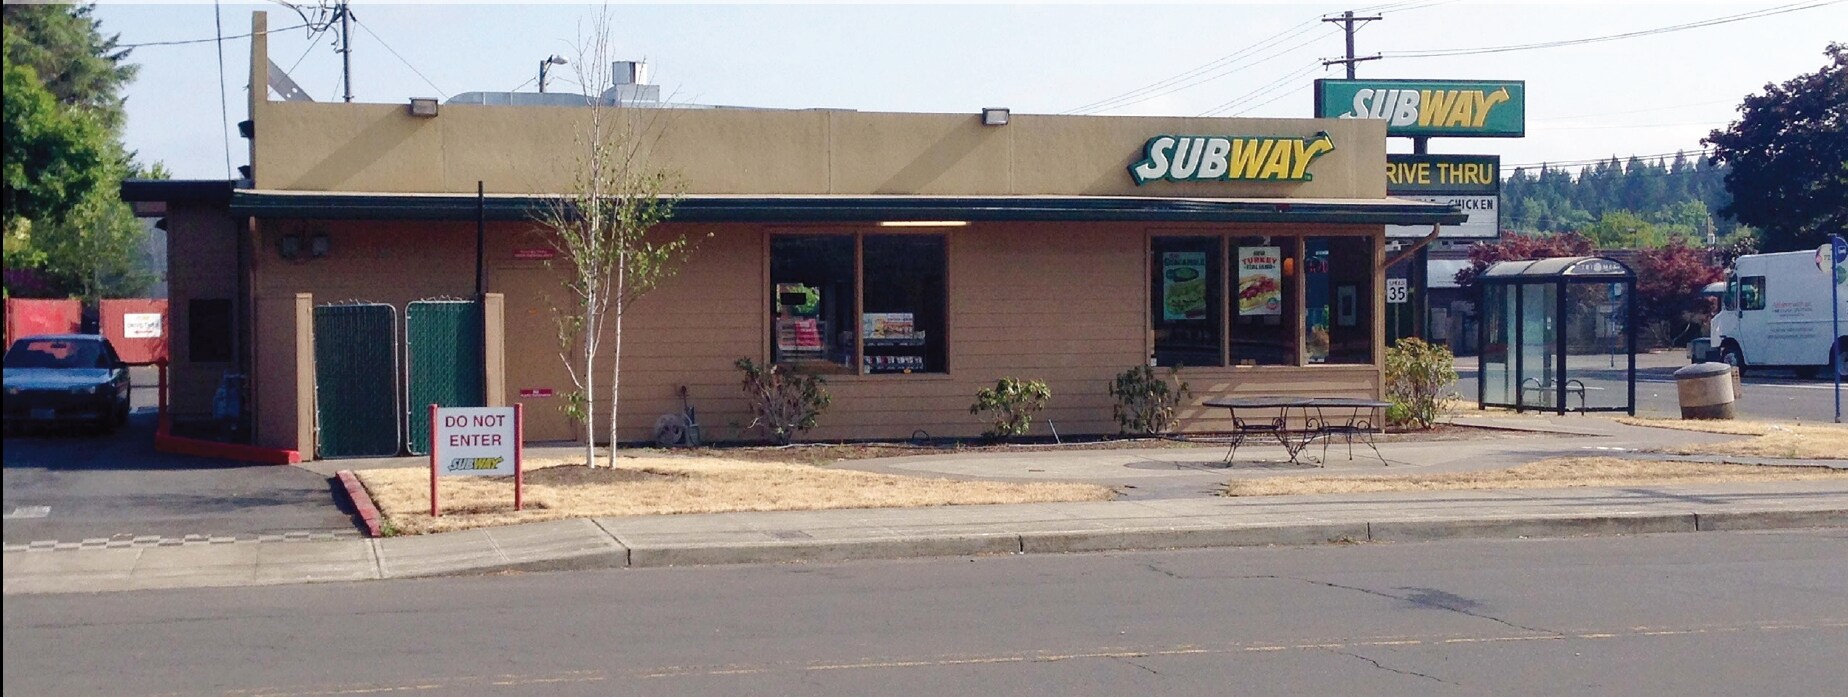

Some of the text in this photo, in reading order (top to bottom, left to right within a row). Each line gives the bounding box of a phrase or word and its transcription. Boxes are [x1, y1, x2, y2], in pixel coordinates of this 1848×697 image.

[1342, 87, 1508, 127] SUBWAY
[1136, 132, 1334, 181] SUBWAY
[1386, 163, 1493, 185] RIVE THRU
[1241, 256, 1278, 265] TURKEY
[1389, 286, 1405, 300] 35
[445, 414, 505, 428] DO NOT
[449, 434, 502, 447] ENTER
[447, 455, 504, 472] SUBWAY
